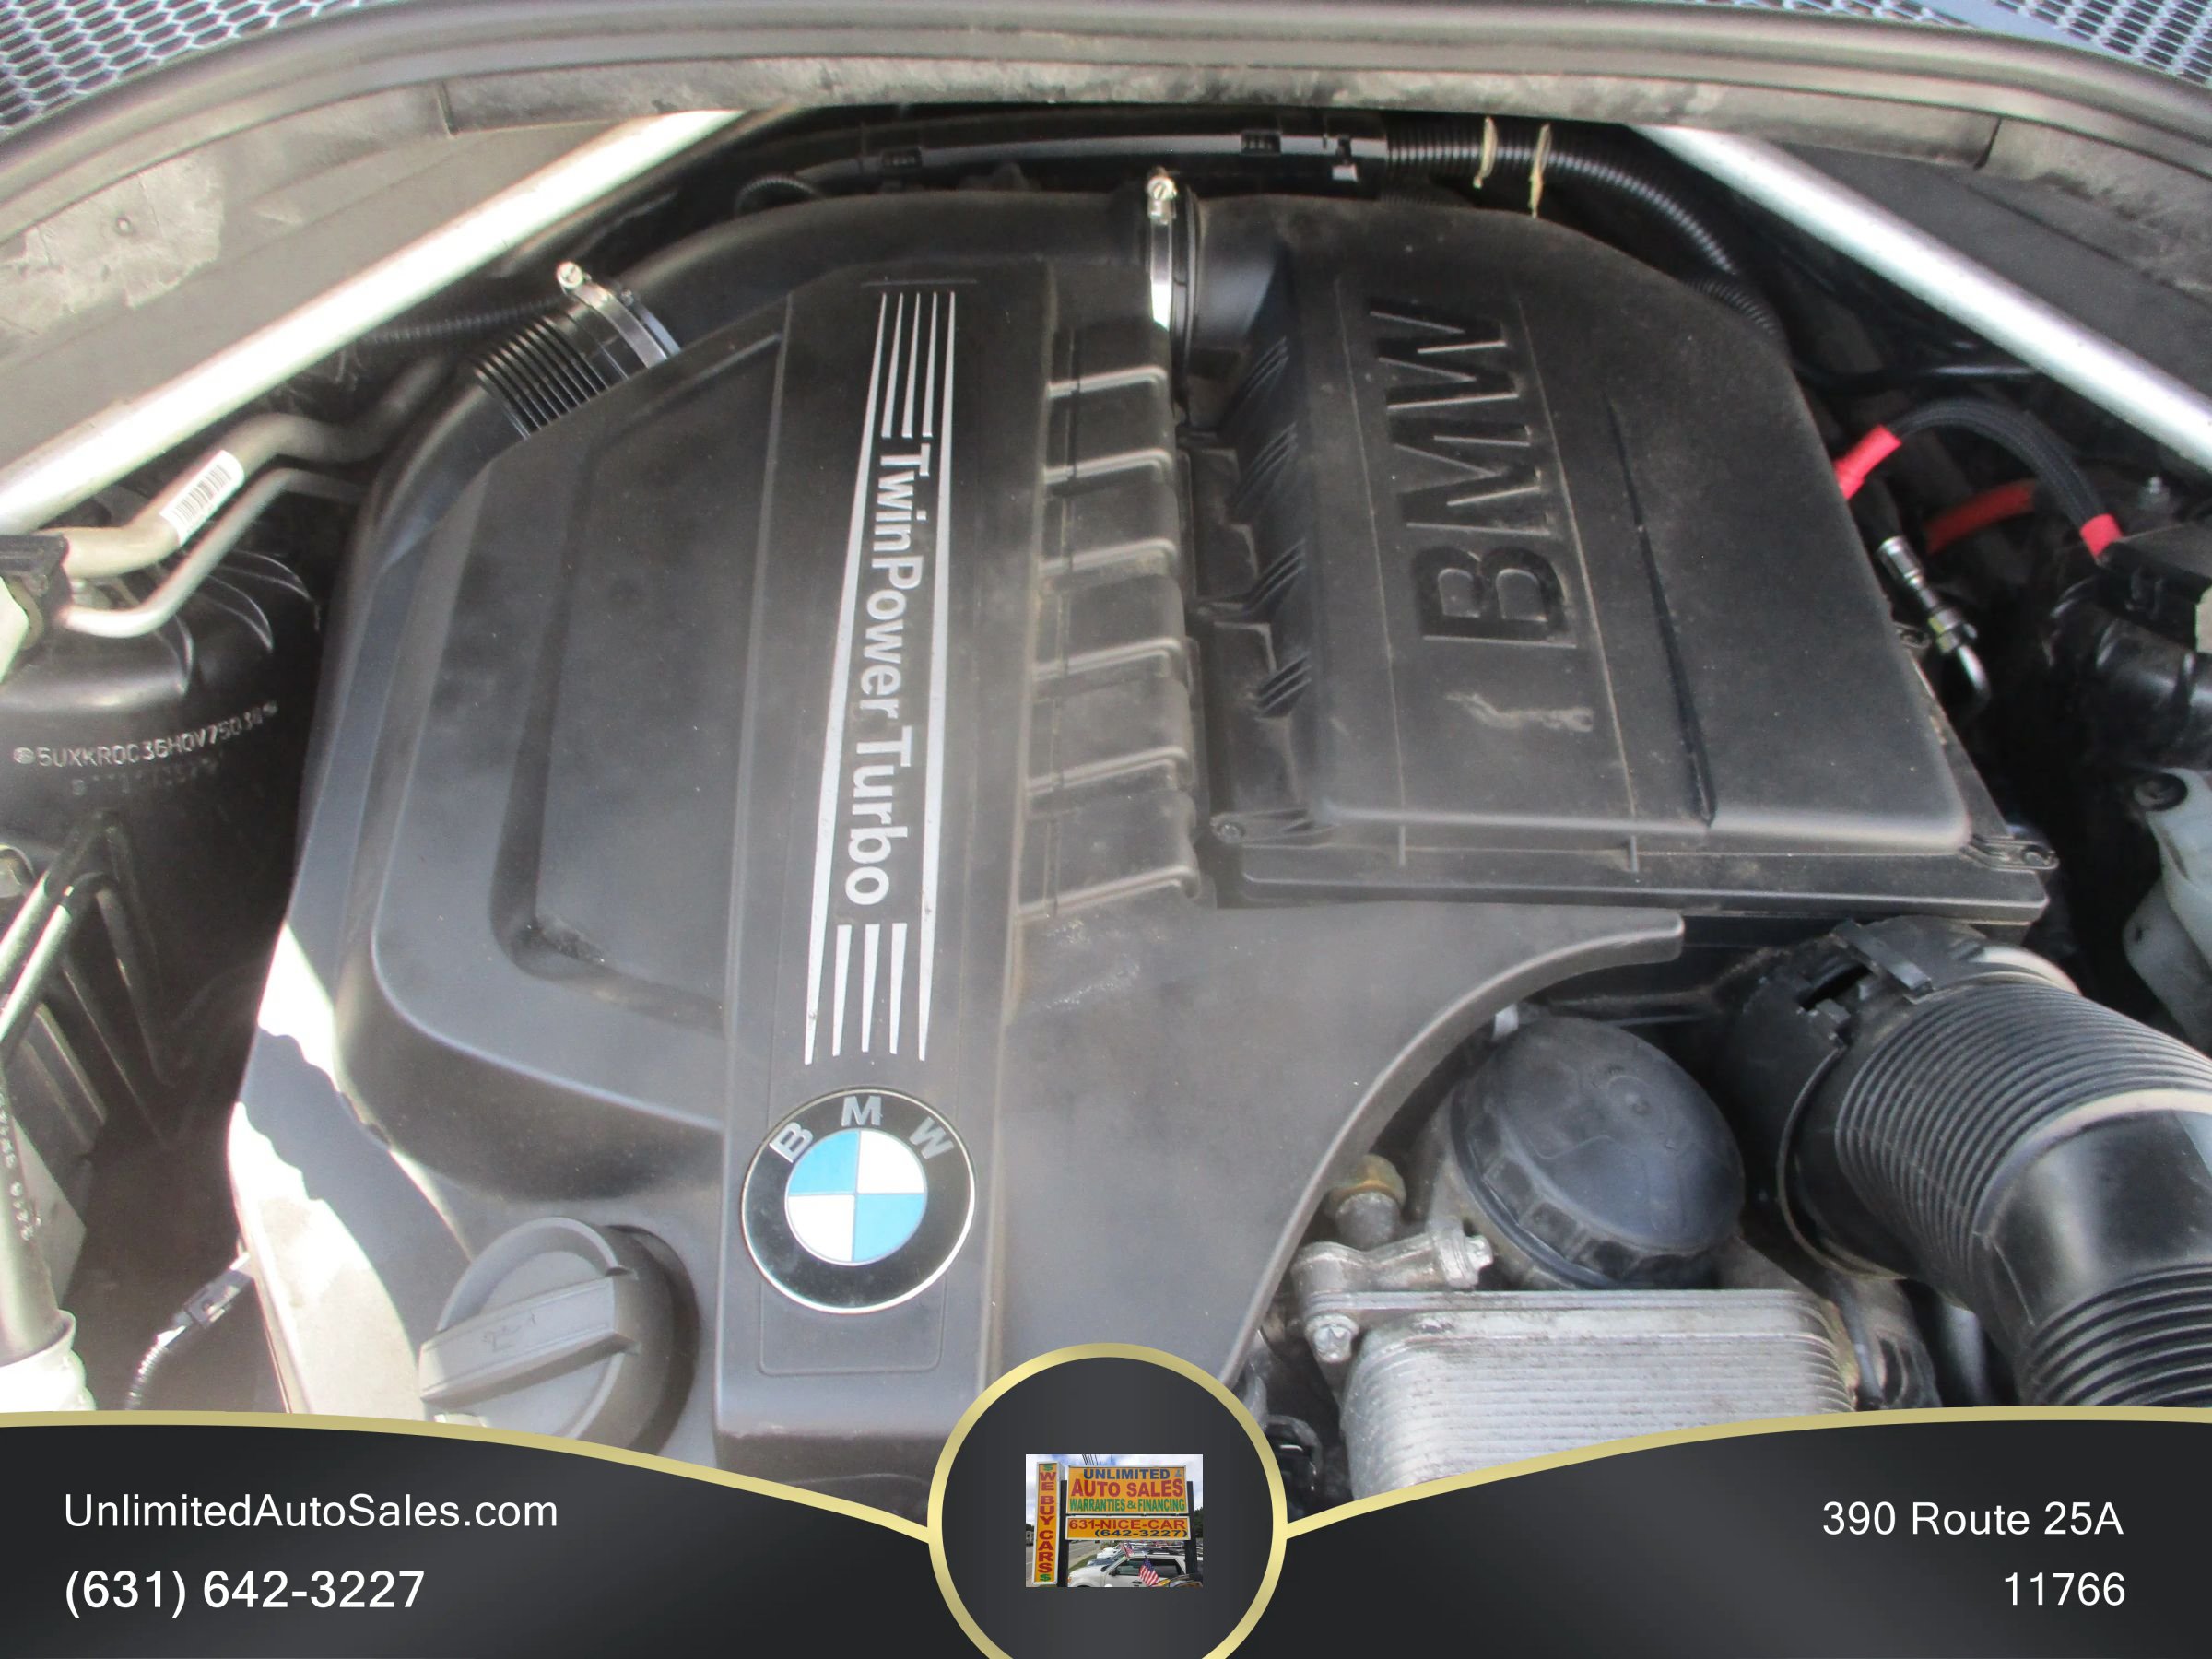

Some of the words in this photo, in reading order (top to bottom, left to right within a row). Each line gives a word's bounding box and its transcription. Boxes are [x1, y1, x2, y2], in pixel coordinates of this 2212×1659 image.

[860, 443, 930, 720] TwinPower
[1368, 296, 1577, 650] BMW
[844, 726, 913, 906] Turbo
[769, 1095, 955, 1164] BMW
